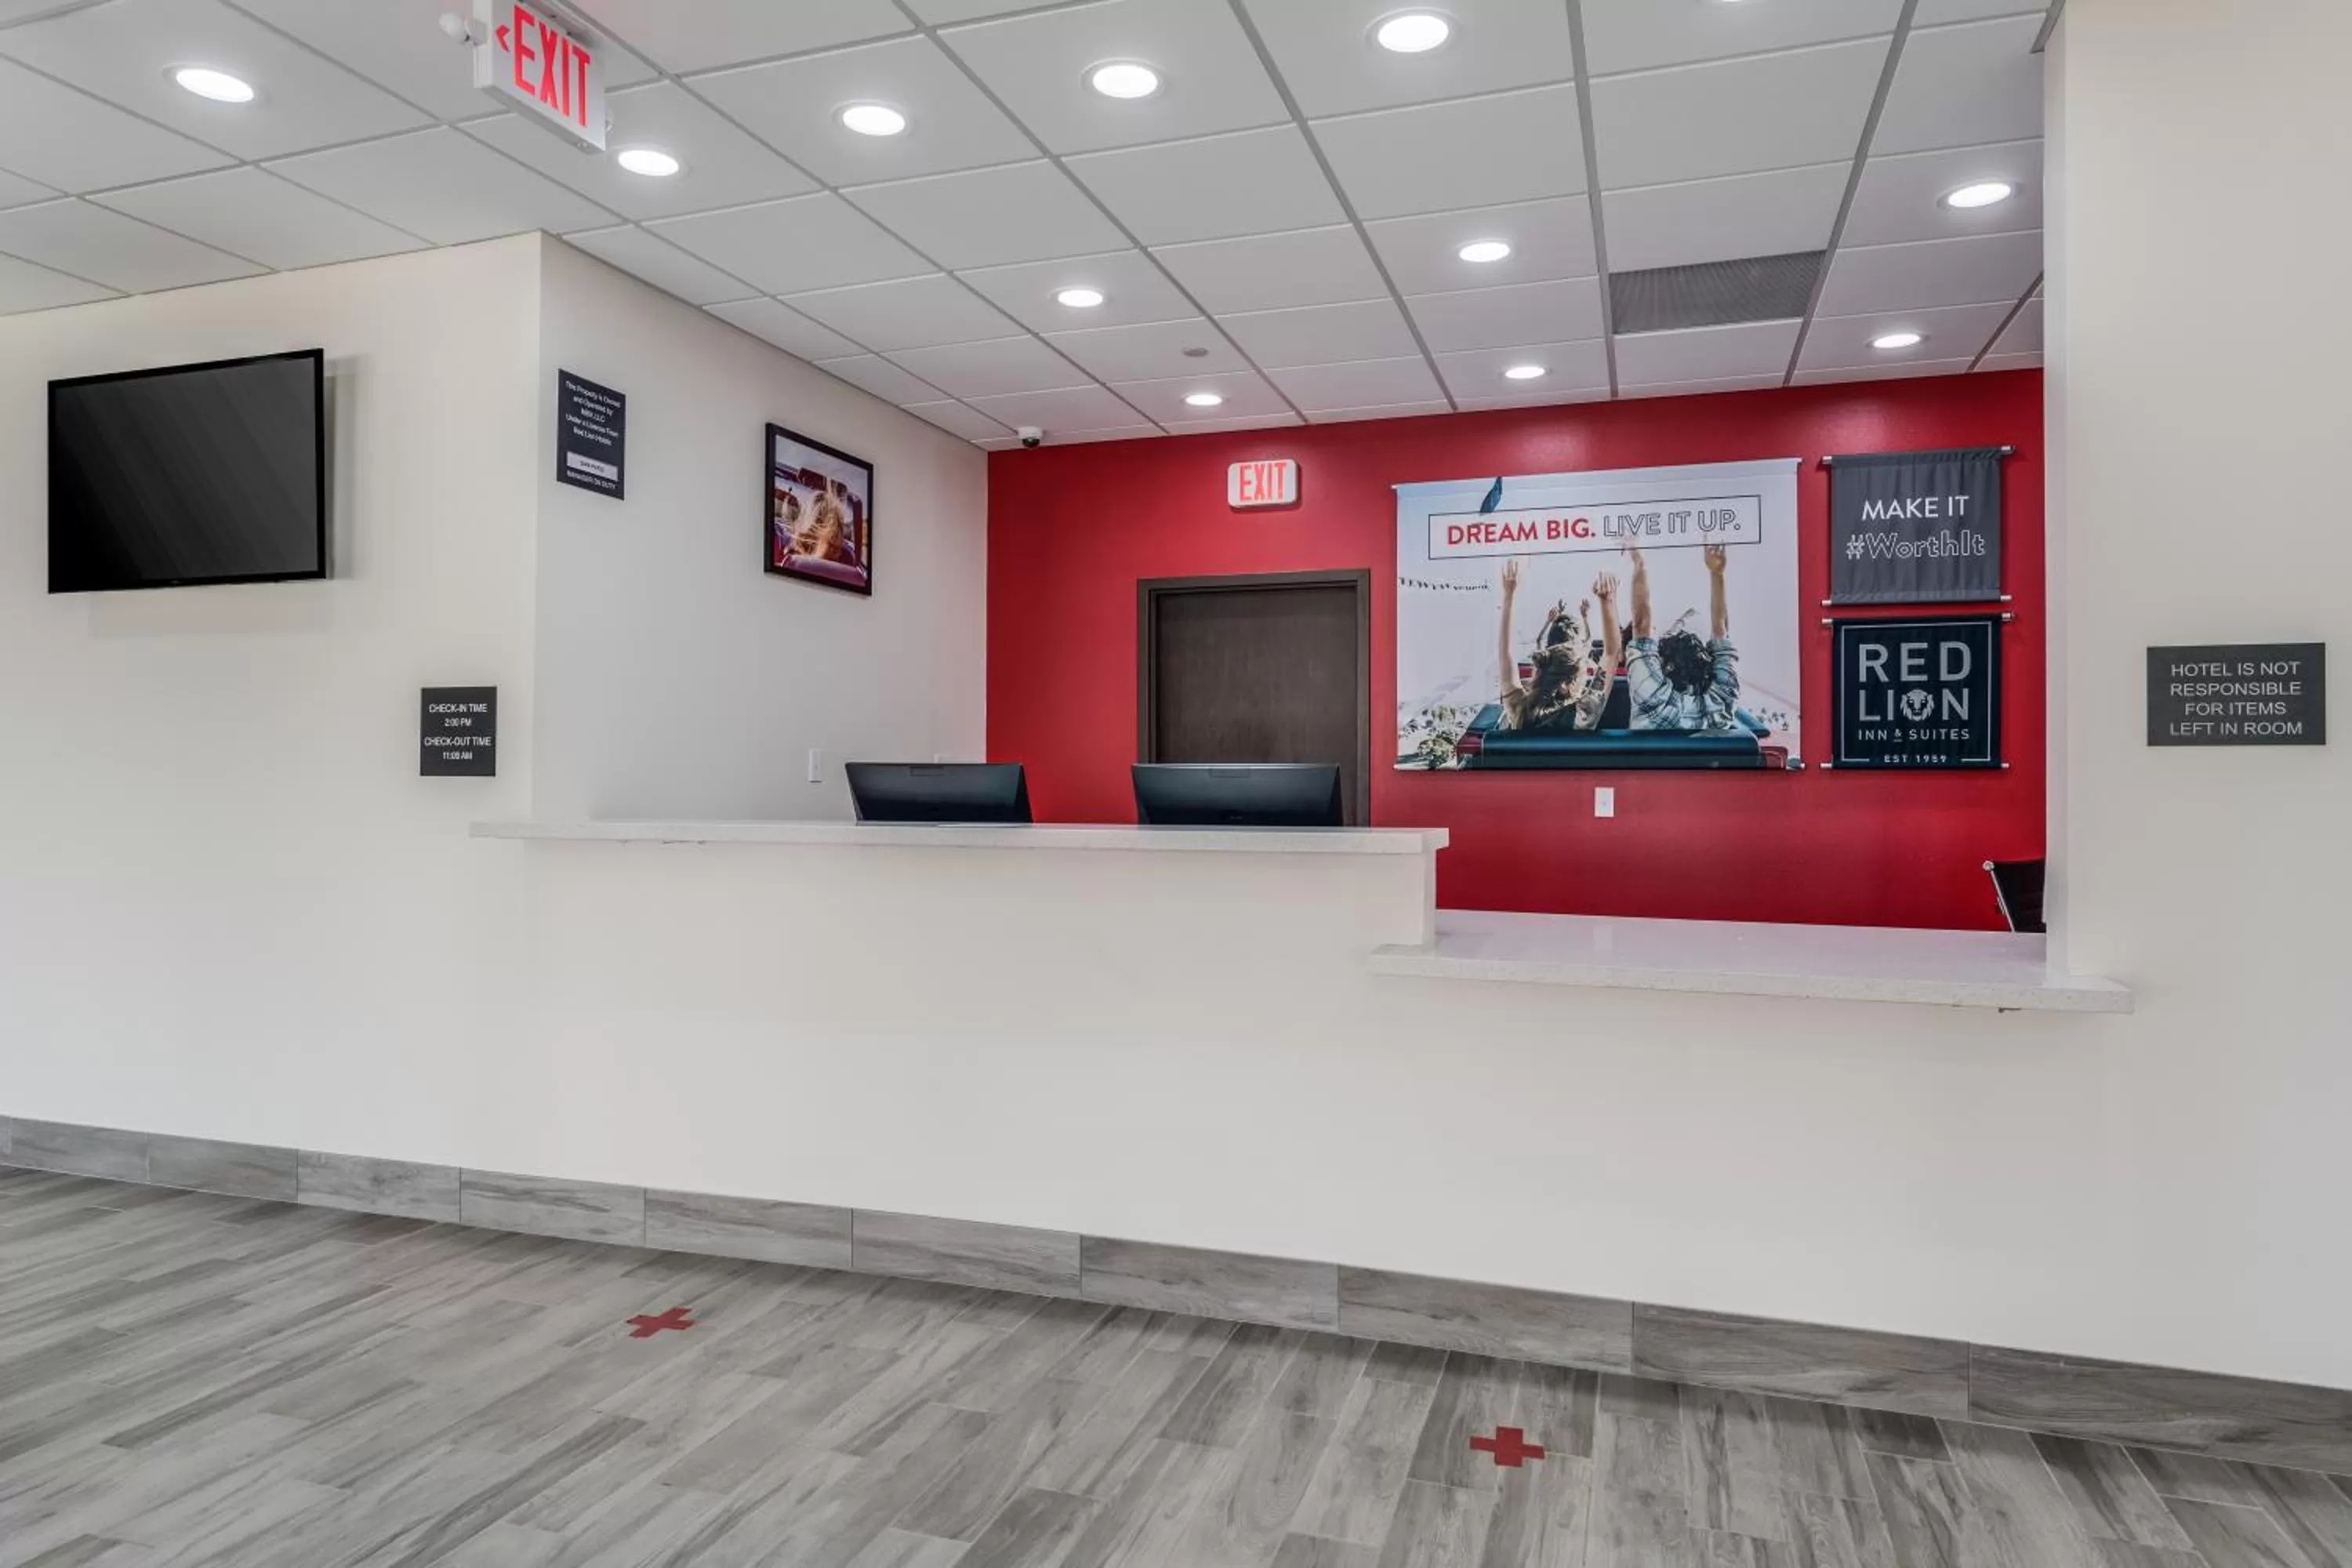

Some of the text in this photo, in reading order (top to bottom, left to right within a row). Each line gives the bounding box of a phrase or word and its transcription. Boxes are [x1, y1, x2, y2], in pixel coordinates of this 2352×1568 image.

[514, 4, 591, 127] EXIT
[1240, 463, 1287, 502] EXIT
[1861, 495, 1969, 521] MAKE IT
[1447, 509, 1741, 546] DREAM BIG. LIVE IT UP.
[1846, 529, 1986, 560] #WorthIt
[1859, 641, 1972, 683] RED
[2171, 661, 2301, 677] HOTEL IS NOT
[2170, 681, 2302, 697] RESPONSIBLE
[429, 703, 488, 713] CHECK-IN TIME
[2184, 702, 2287, 716] FOR ITEMS
[460, 717, 472, 727] PM
[2169, 721, 2303, 736] LEFT IN ROOM
[424, 736, 492, 746] CHECK-OUT TIME
[1858, 728, 1970, 742] INN & SUITES
[461, 751, 473, 760] AM
[1884, 753, 1947, 763] EST 1959
